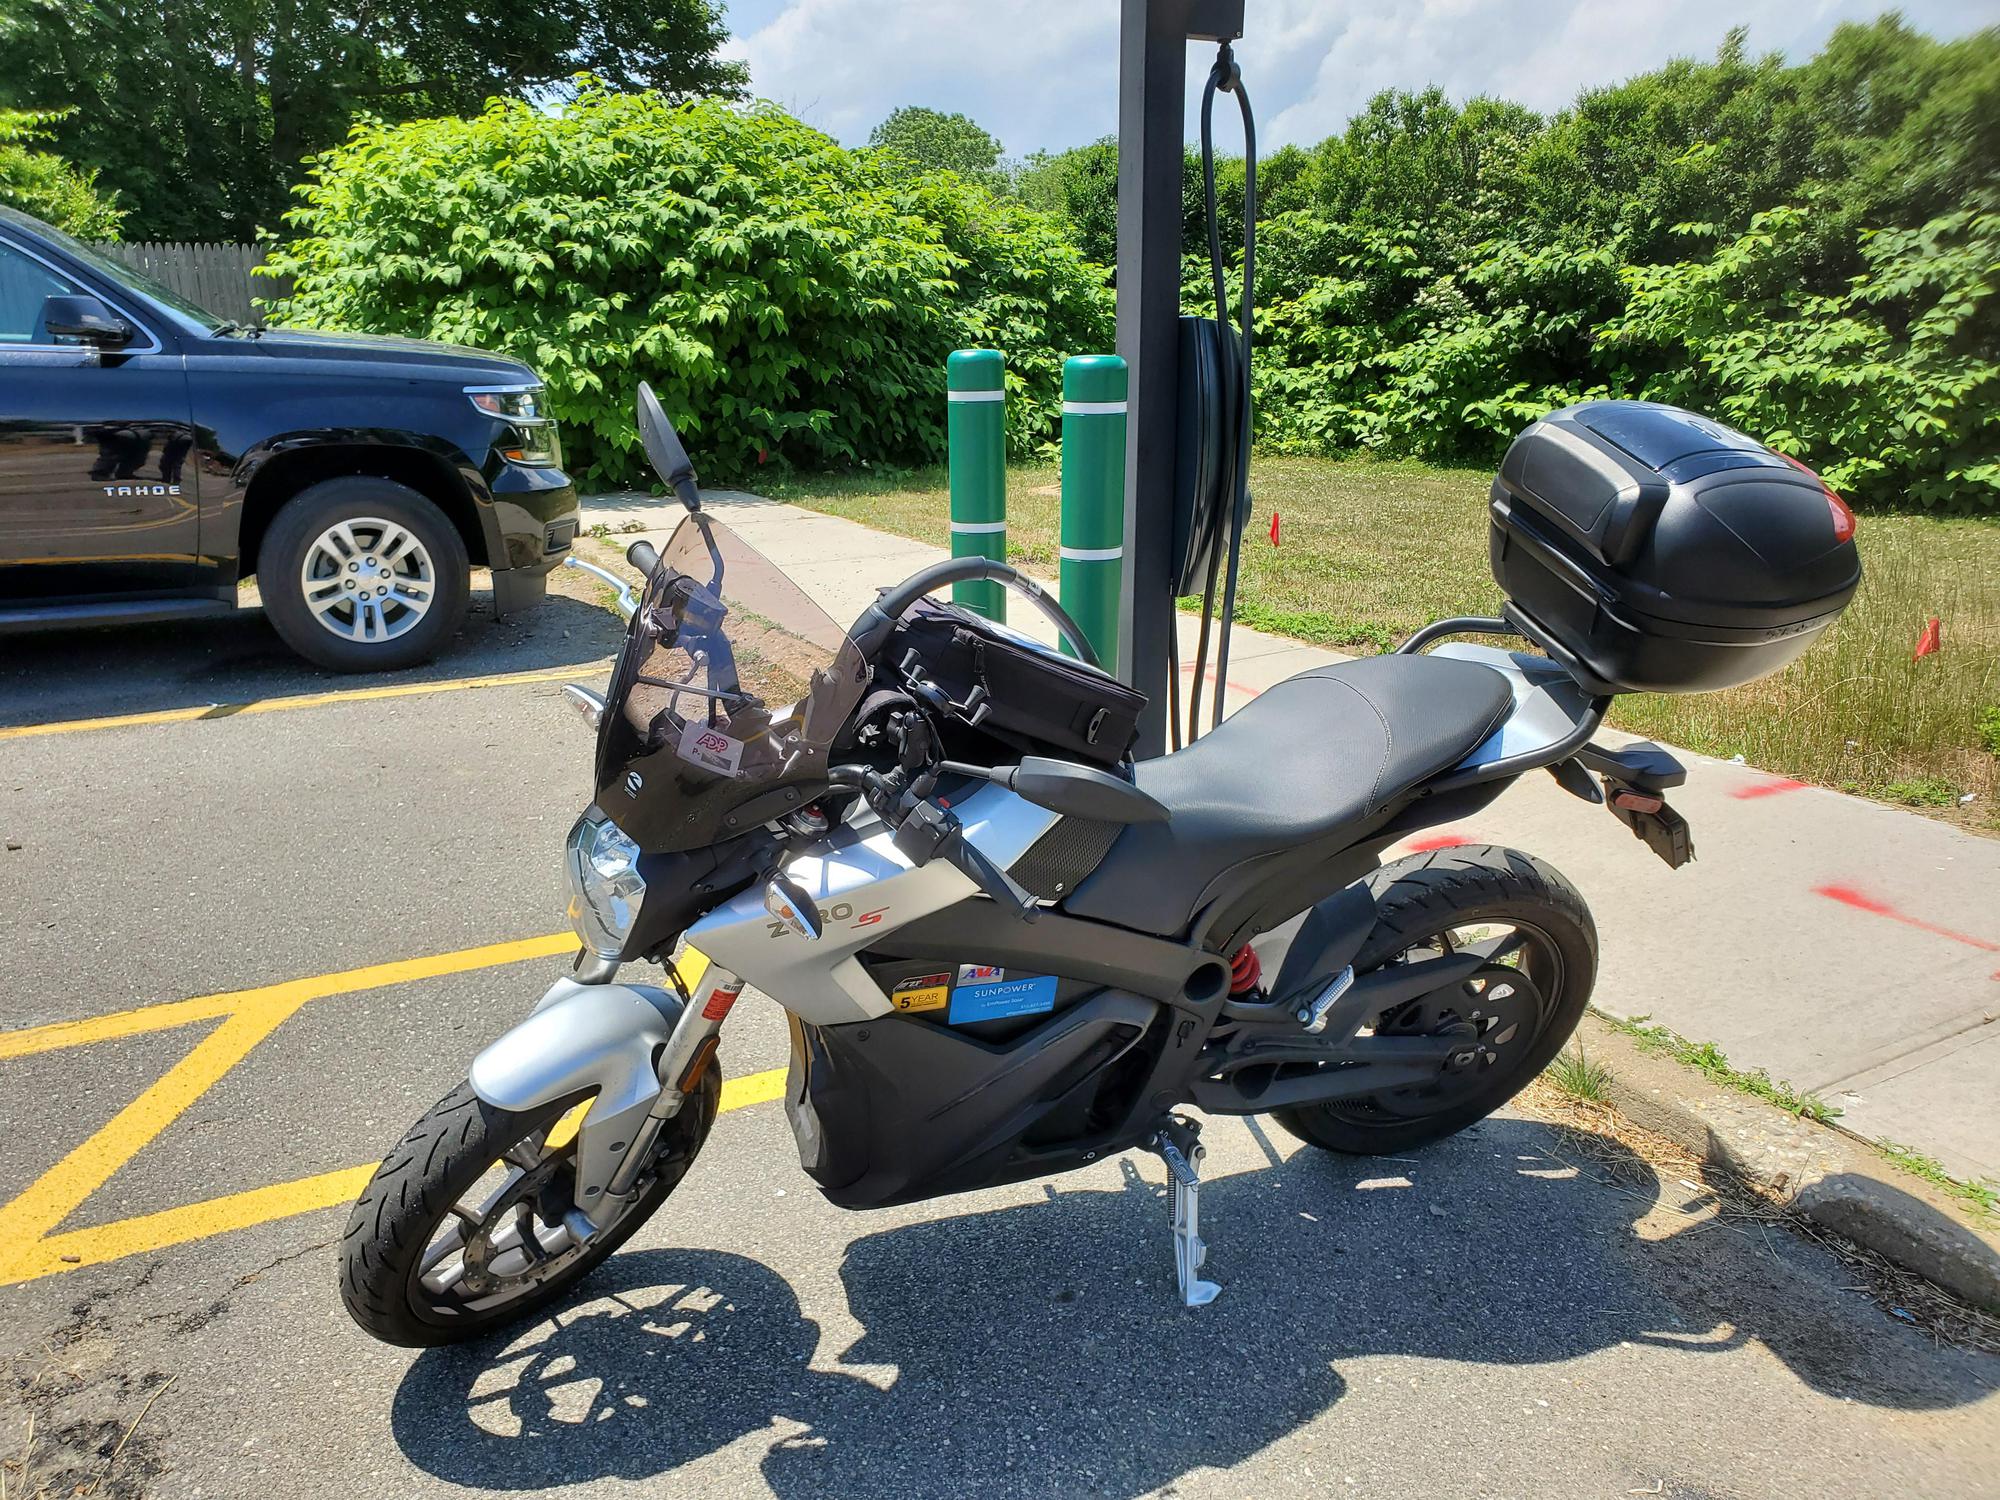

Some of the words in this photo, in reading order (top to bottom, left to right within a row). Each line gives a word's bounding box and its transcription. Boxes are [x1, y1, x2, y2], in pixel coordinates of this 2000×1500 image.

[103, 485, 181, 497] TAHOE
[696, 732, 729, 753] ADP
[766, 902, 853, 939] ZRO
[974, 983, 1034, 998] SUNPOWER
[900, 996, 911, 1009] 5
[911, 992, 939, 1002] YEAR
